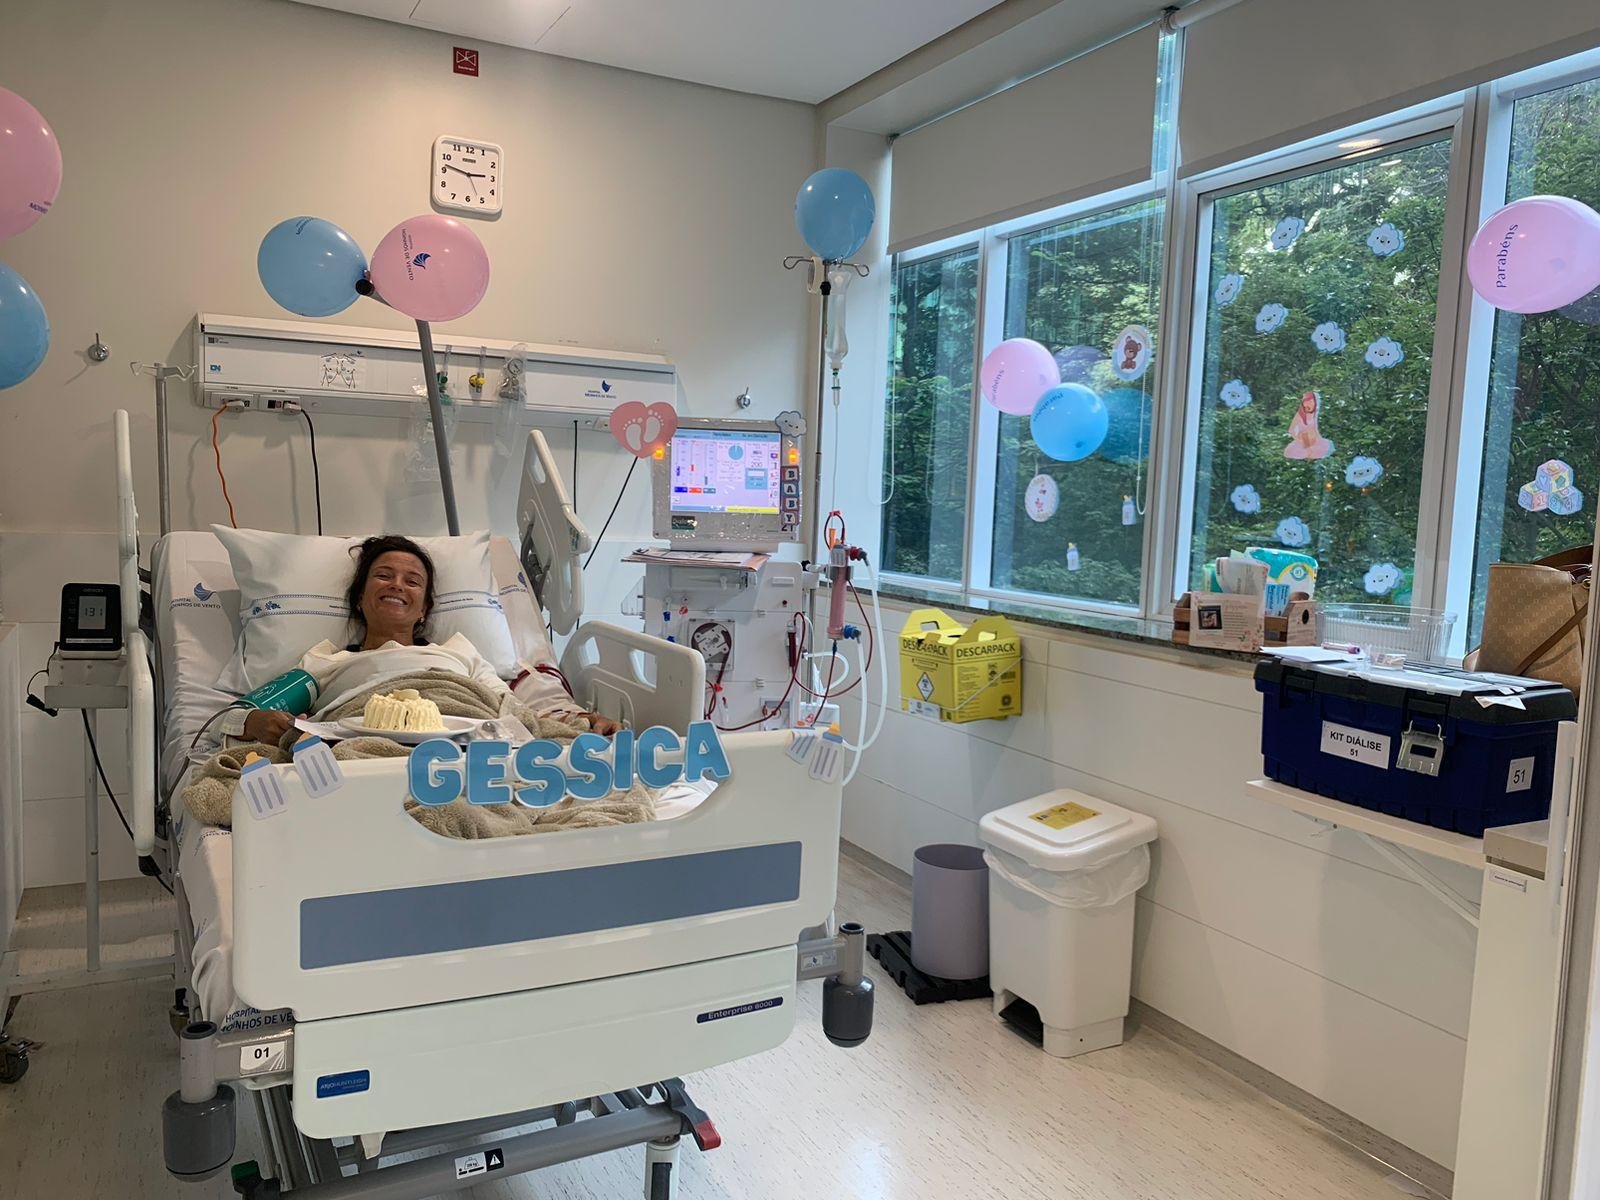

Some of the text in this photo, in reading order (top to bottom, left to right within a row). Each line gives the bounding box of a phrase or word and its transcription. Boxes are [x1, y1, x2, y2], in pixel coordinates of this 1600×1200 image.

[452, 144, 461, 152] 11
[465, 146, 475, 155] 12
[442, 153, 452, 161] 10
[441, 166, 447, 174] 9
[490, 161, 496, 169] 2
[440, 180, 447, 188] 8
[490, 175, 496, 183] 3
[489, 188, 495, 196] 4
[450, 192, 485, 204] 7 6 5
[956, 642, 1016, 658] DESCARPACK
[1330, 730, 1382, 752] KIT DIÁLISE
[1349, 748, 1359, 757] 51
[408, 721, 733, 809] GESSICA
[1512, 769, 1526, 785] 51
[708, 1004, 754, 1020] Enterprise
[264, 1013, 278, 1025] DE
[254, 1046, 270, 1060] 01
